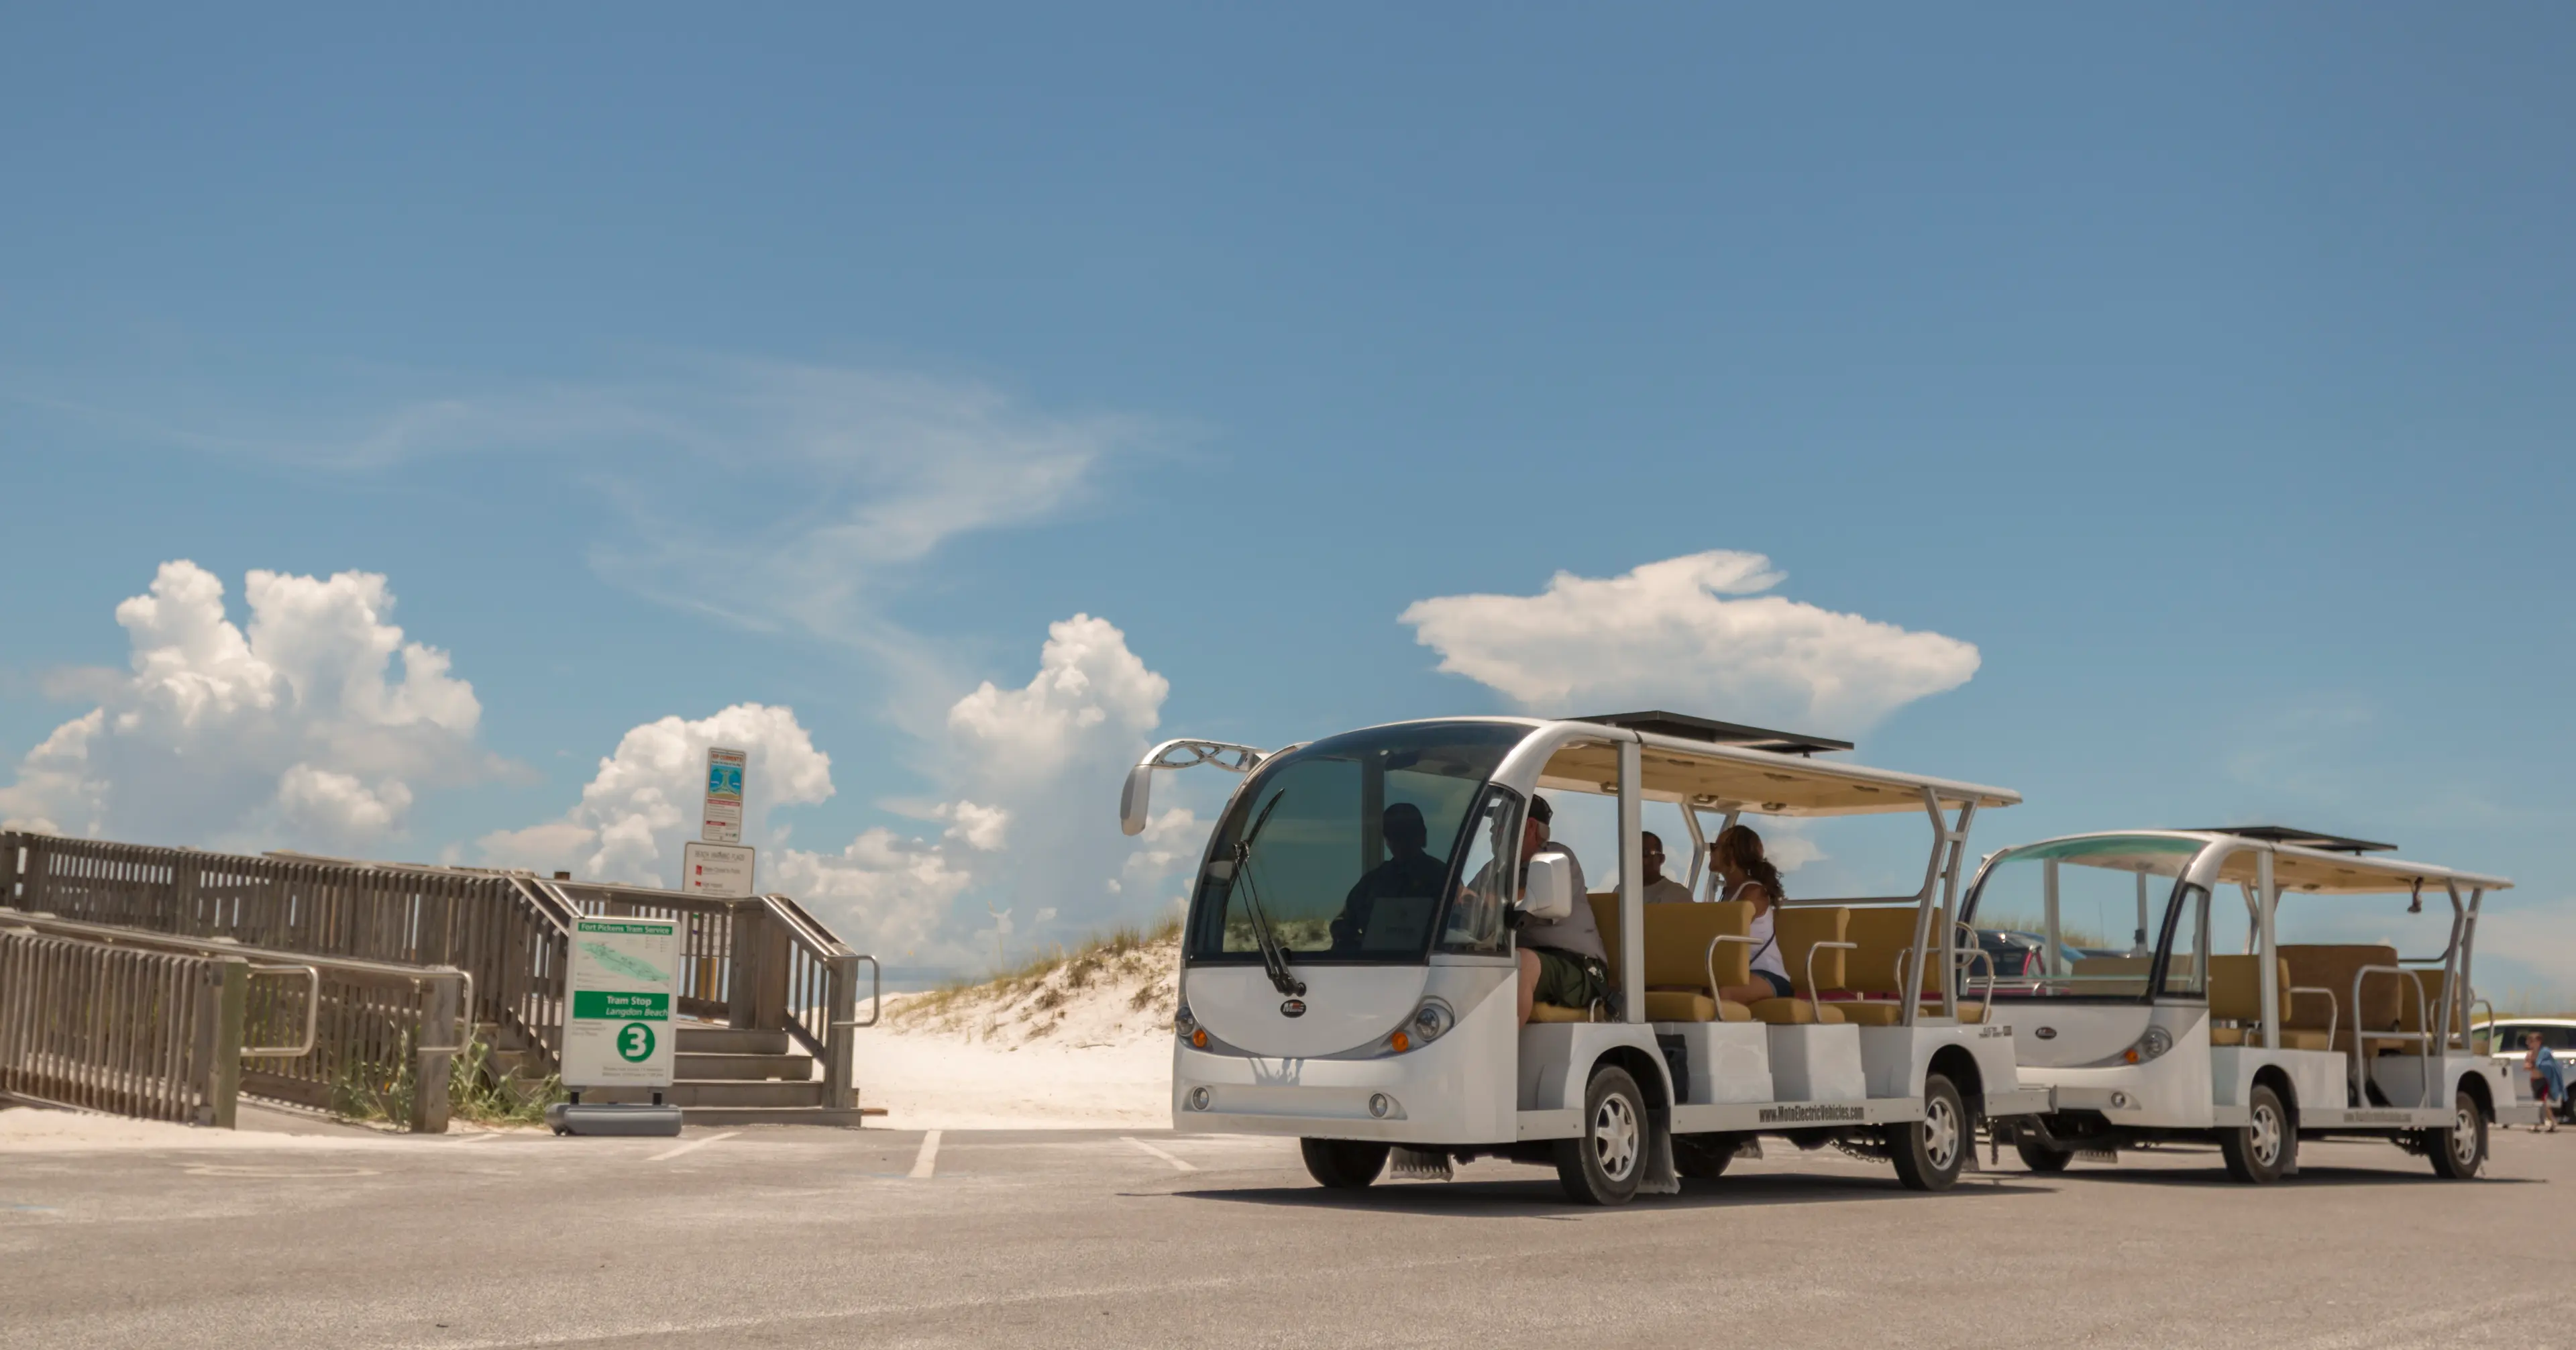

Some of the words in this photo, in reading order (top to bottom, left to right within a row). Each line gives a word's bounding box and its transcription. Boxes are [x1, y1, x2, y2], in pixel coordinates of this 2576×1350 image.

[626, 925, 643, 933] Tram
[645, 926, 669, 934] Service
[606, 996, 629, 1004] Tram
[631, 996, 652, 1007] Stop
[606, 1008, 643, 1017] Langdon
[644, 1008, 669, 1017] Beach
[625, 1026, 646, 1057] 3
[1759, 1104, 1864, 1123] www.MotoElectricVehicles.com
